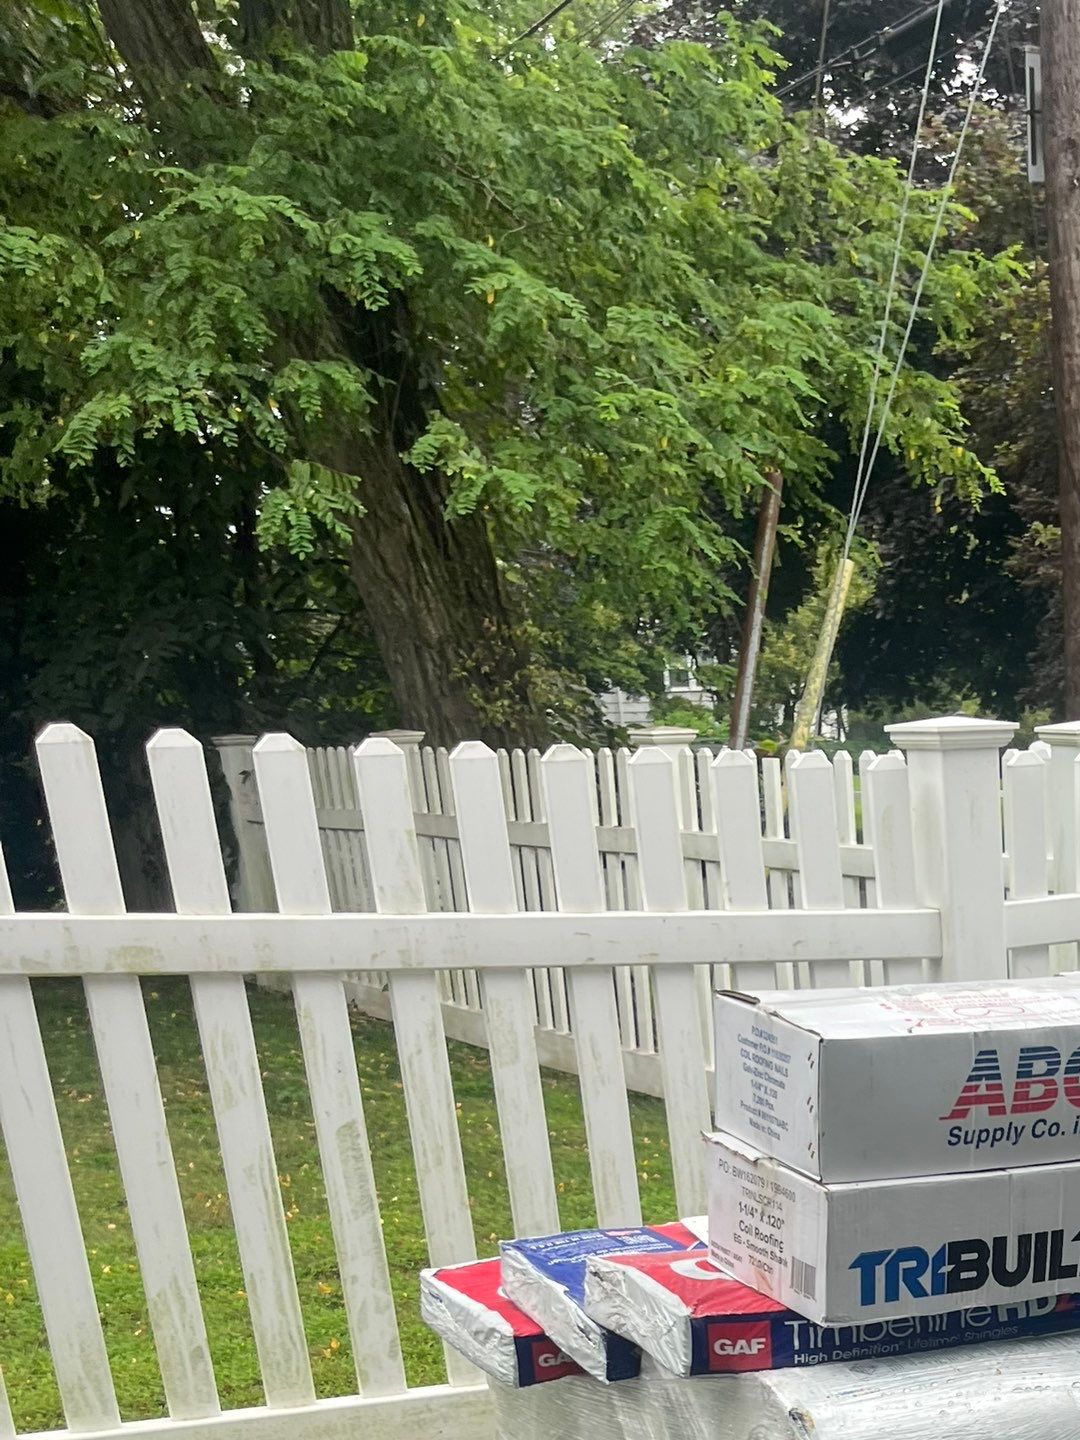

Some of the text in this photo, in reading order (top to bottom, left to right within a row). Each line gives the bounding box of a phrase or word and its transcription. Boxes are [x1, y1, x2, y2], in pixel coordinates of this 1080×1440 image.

[948, 1121, 1025, 1149] Supply
[1031, 1118, 1065, 1139] Co.
[739, 1220, 753, 1237] Coil
[754, 1227, 784, 1254] Roofing
[538, 1352, 573, 1367] GA
[713, 1336, 766, 1356] GAF
[794, 1352, 829, 1366] High
[832, 1343, 900, 1361] Definition
[963, 1325, 1019, 1343] Shingles
